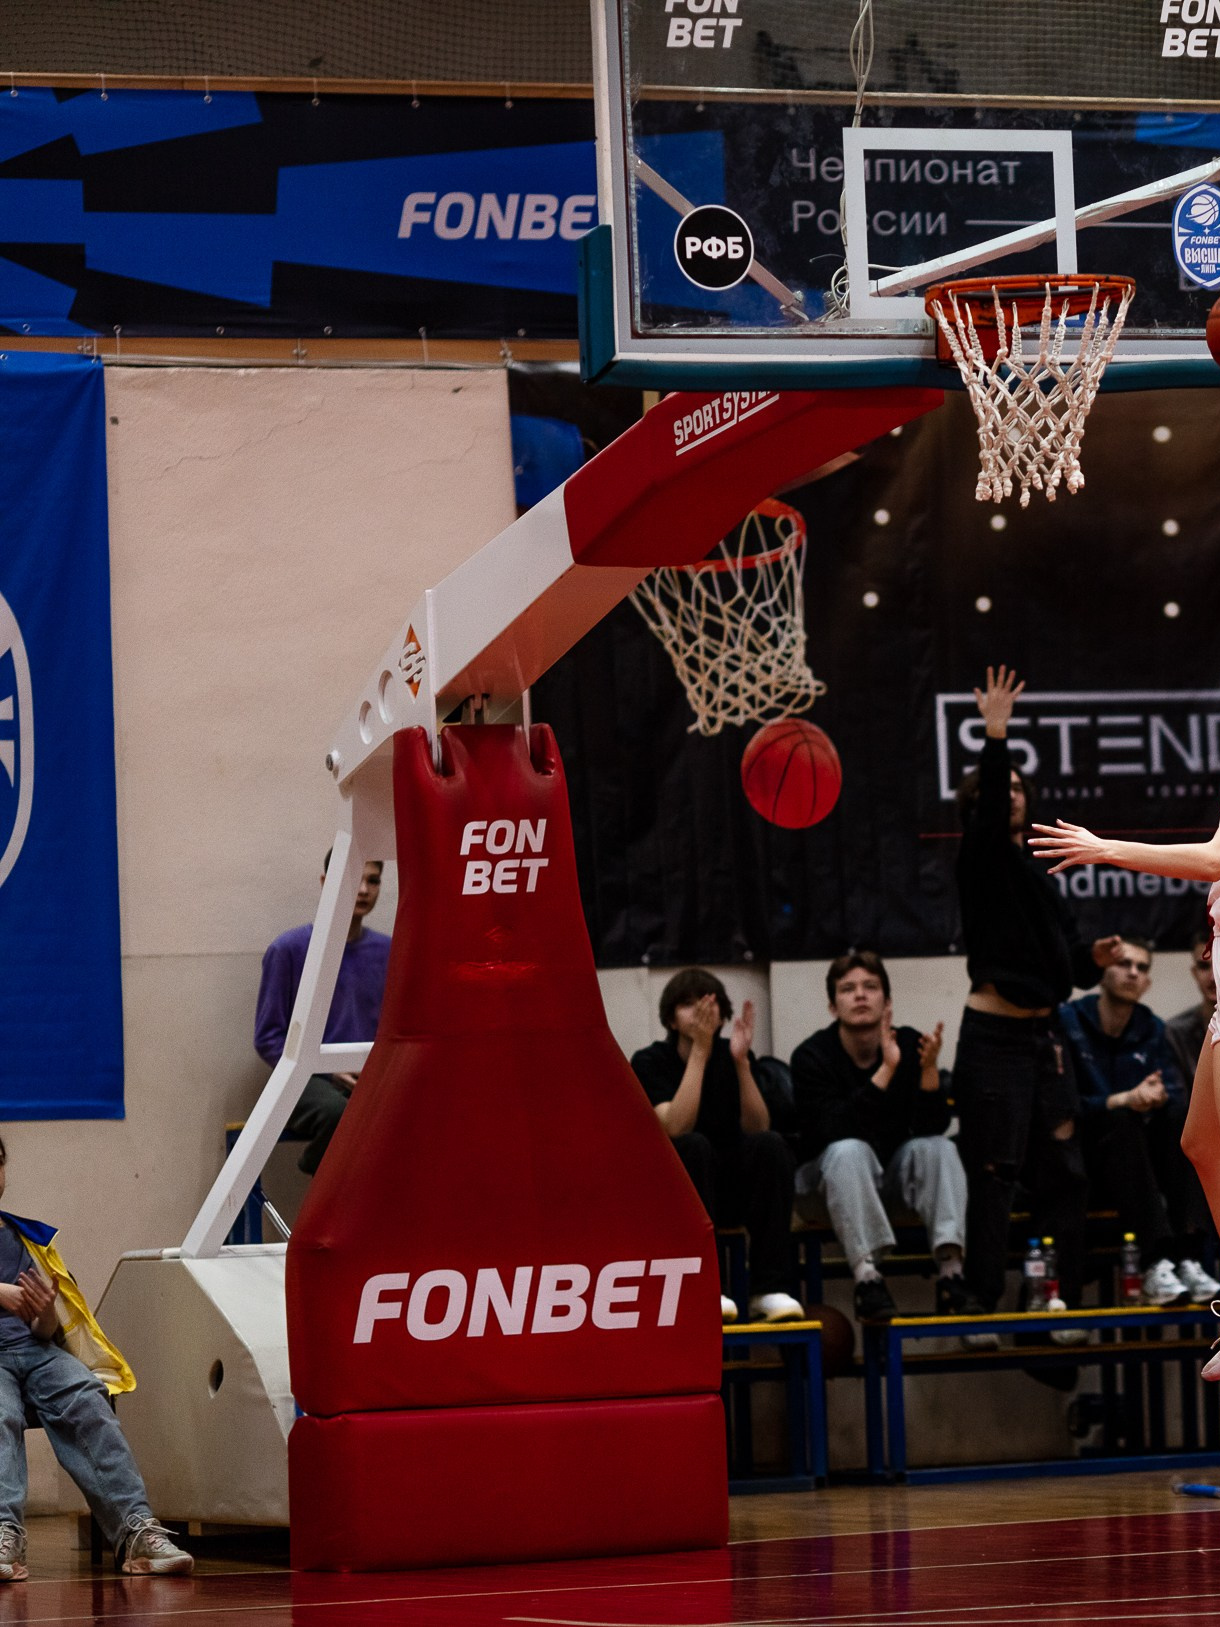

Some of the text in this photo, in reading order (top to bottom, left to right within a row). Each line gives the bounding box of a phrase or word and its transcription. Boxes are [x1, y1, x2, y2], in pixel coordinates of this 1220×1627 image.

[666, 17, 743, 48] BET
[791, 148, 1021, 185] Чепионат
[397, 191, 597, 241] FONBE
[792, 200, 948, 236] Росии
[685, 236, 744, 259] РФБ
[1200, 264, 1217, 274] ЛИГА
[460, 818, 547, 855] FON
[462, 858, 549, 895] BET
[353, 1257, 702, 1344] FONBET
